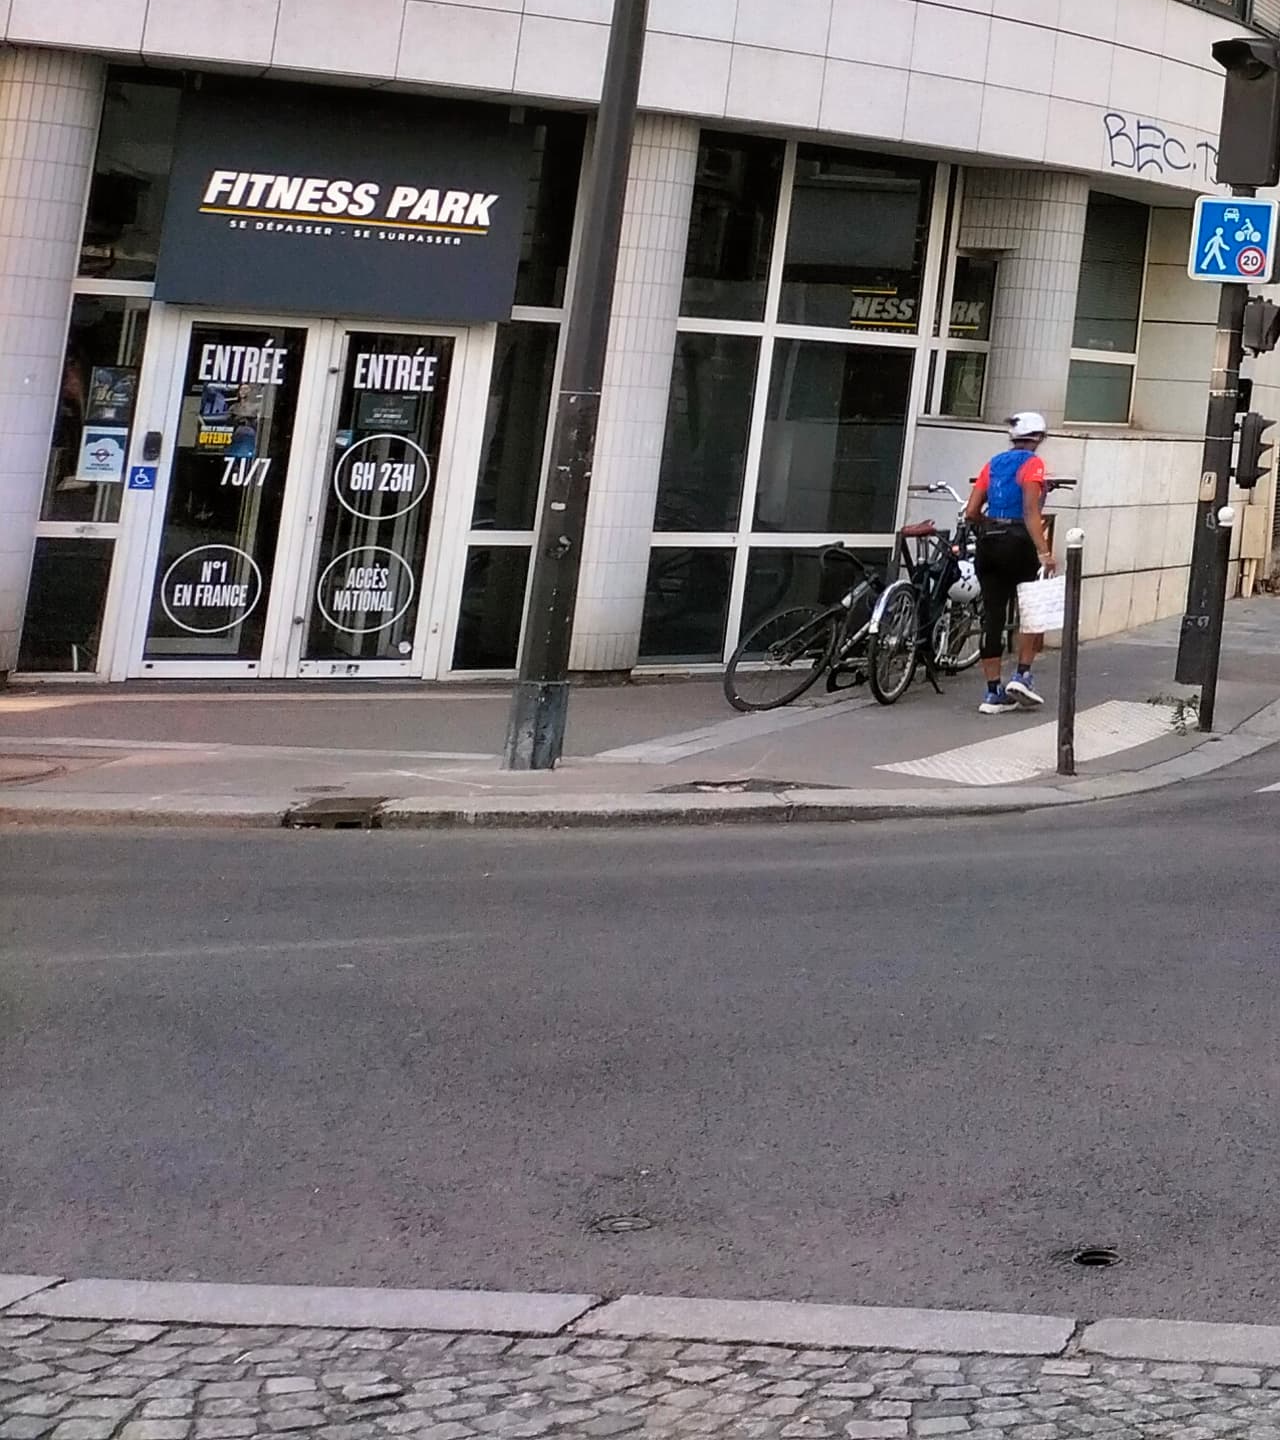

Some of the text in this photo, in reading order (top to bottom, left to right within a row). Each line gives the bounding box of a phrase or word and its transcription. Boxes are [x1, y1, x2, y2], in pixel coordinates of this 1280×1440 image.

[202, 170, 499, 227] FITNESS PARK
[229, 219, 247, 230] SE
[256, 220, 333, 236] DÉPASSER
[354, 229, 371, 239] SE
[379, 231, 462, 246] SURPASSER
[1242, 255, 1259, 267] 20
[851, 296, 915, 320] NESS
[198, 339, 288, 385] ENTRÉE
[353, 347, 437, 391] ENTRÉE
[220, 456, 272, 486] 7J/7
[350, 461, 415, 492] 6H 23H
[345, 563, 389, 589] ACCÈS
[173, 584, 248, 607] EN FRANCE
[333, 590, 394, 612] NATIONAL
